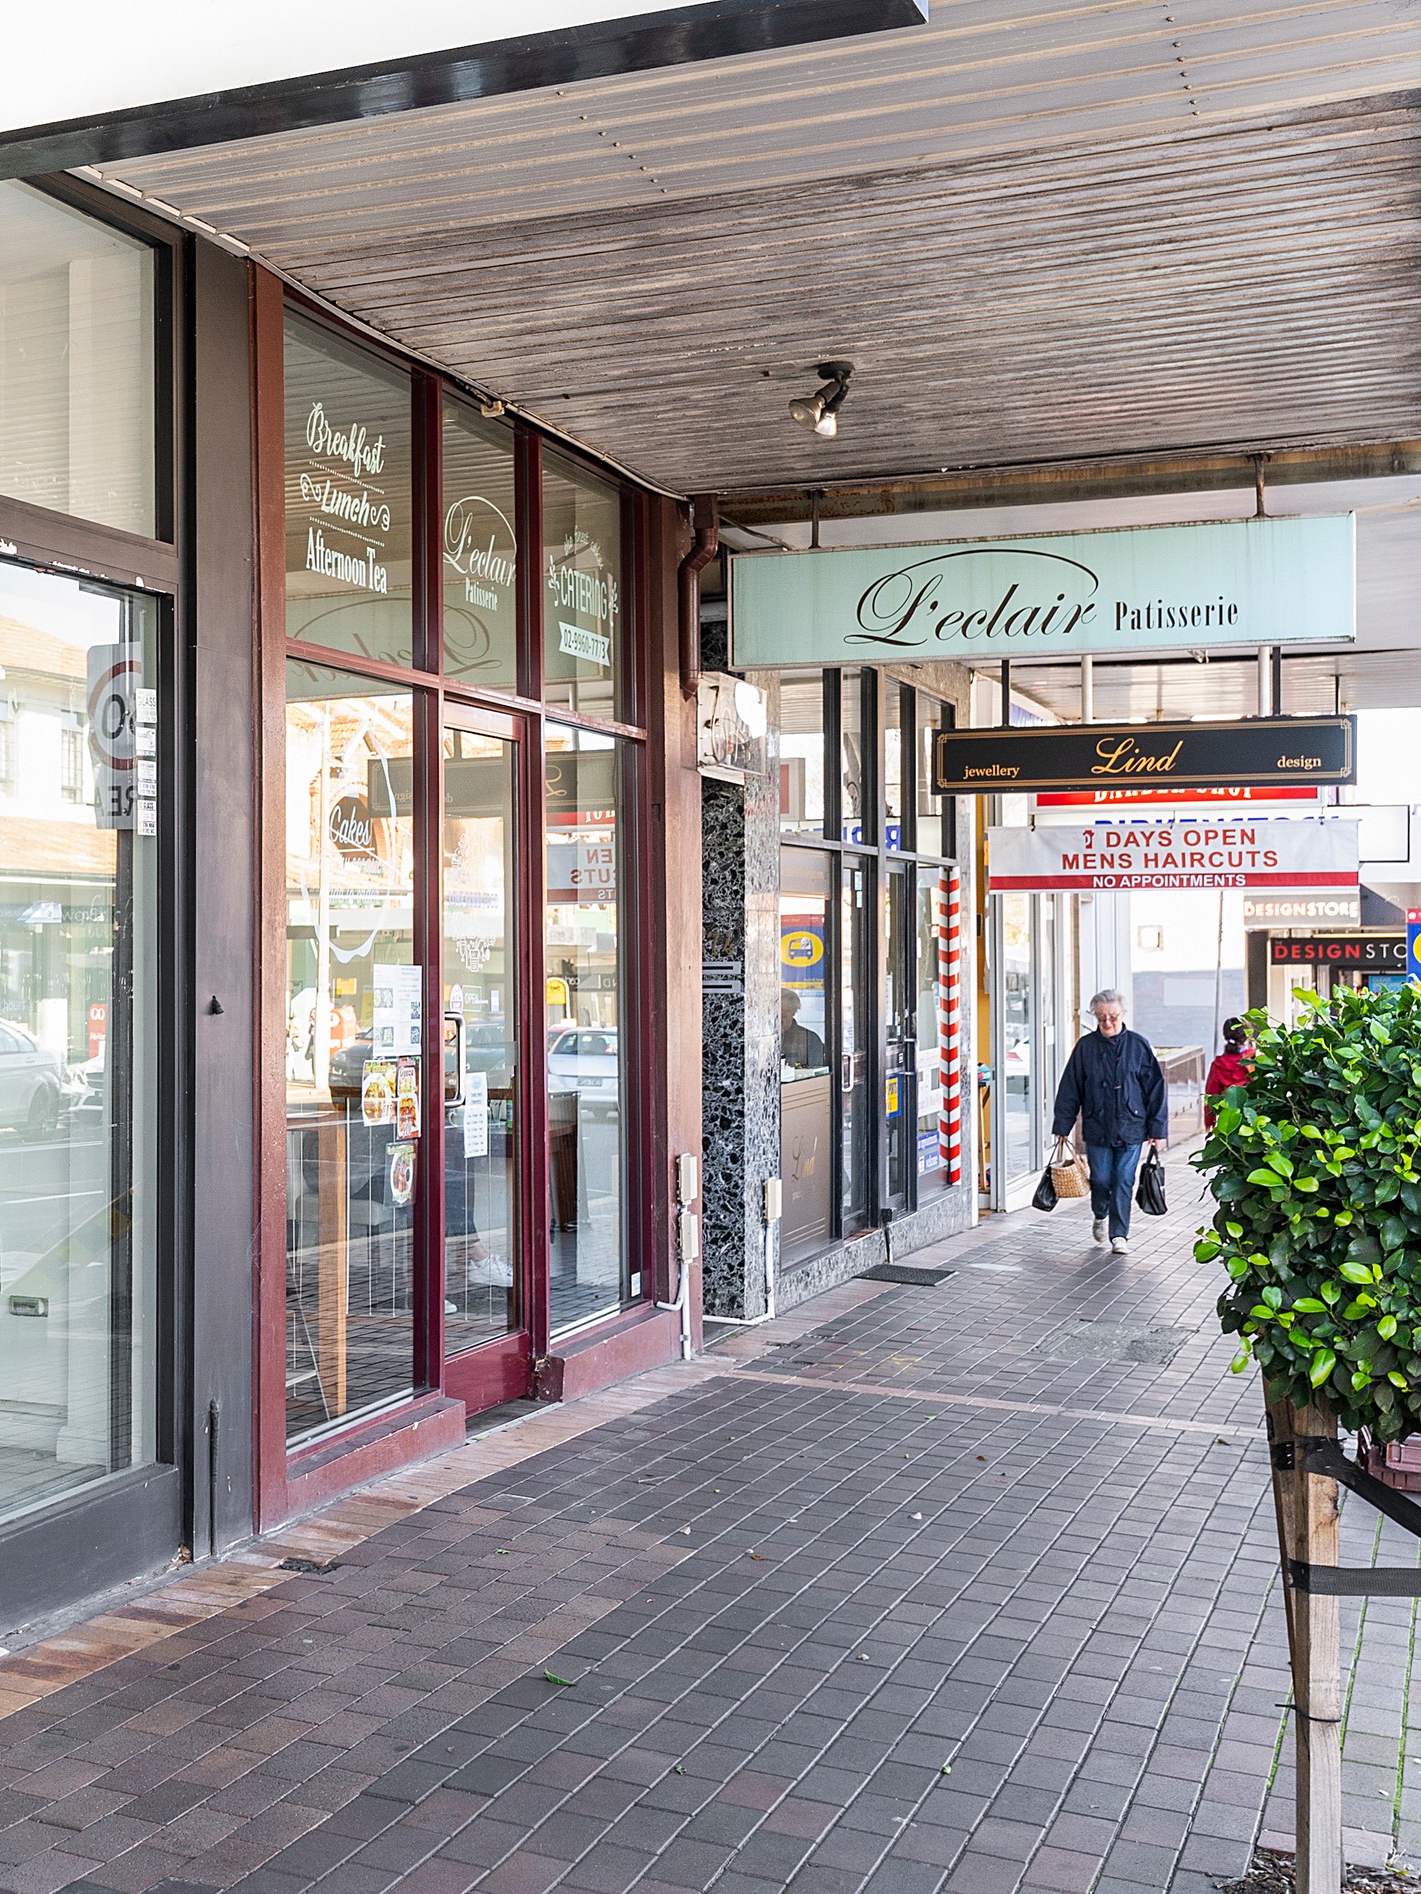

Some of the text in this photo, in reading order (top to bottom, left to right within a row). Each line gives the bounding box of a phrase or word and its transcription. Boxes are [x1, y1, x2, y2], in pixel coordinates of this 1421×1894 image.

[306, 402, 386, 478] Breakfast
[321, 479, 370, 527] Lunch
[306, 527, 388, 595] Afternoon Tea
[465, 576, 498, 611] Patisserie
[560, 565, 608, 620] CATERING
[843, 549, 1239, 646] L'eclair Patisserie
[963, 764, 1020, 780] jewellery
[1091, 737, 1184, 774] Lind
[1277, 755, 1322, 770] design
[330, 805, 371, 846] Cakes
[1105, 830, 1173, 848] DAYS
[1183, 828, 1256, 848] OPEN
[1062, 850, 1279, 870] MENS HAIRCUTS
[1093, 873, 1247, 888] NO APPOINTMENTS
[1274, 943, 1408, 960] DESIGN STO
